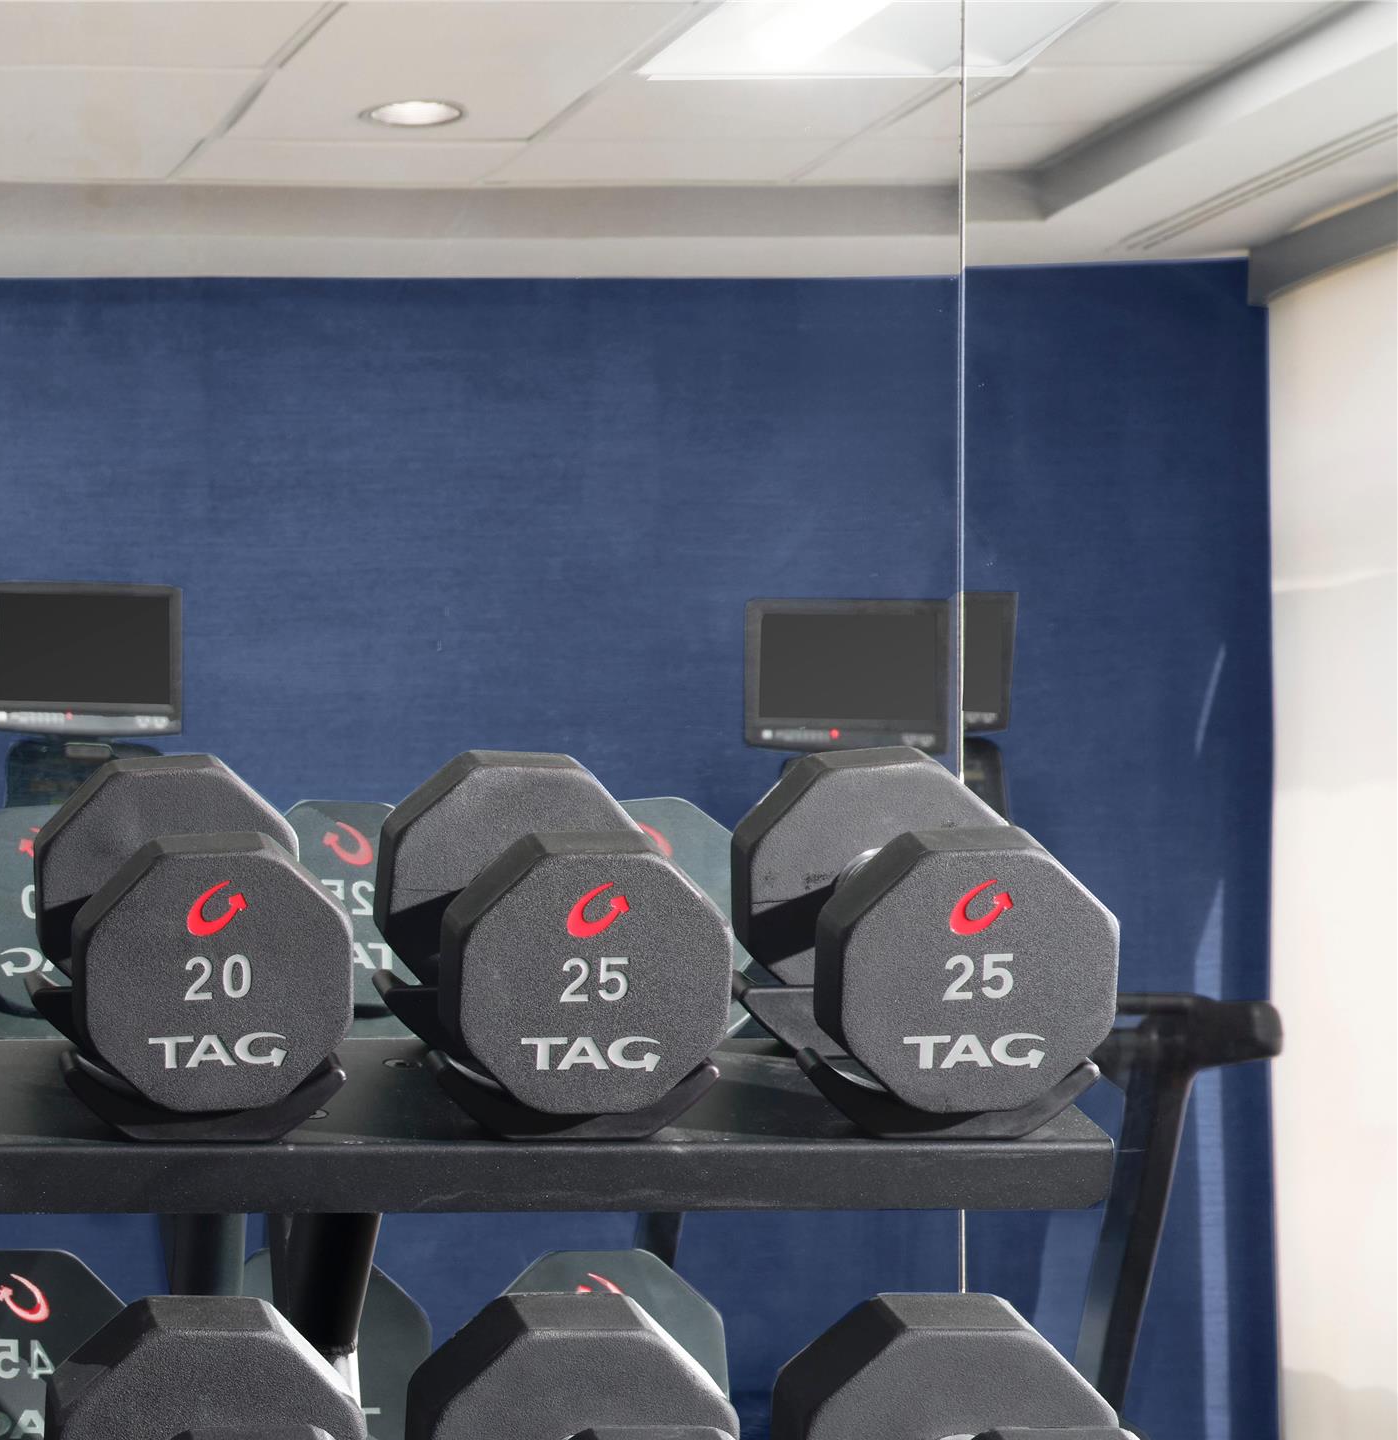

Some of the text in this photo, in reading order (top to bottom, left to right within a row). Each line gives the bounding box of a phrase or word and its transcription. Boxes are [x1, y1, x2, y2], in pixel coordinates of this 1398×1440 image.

[182, 952, 252, 1003] 20
[558, 955, 629, 1004] 25
[941, 951, 1015, 1002] 25
[147, 1030, 287, 1070] TAG
[519, 1034, 661, 1073] TAG
[901, 1031, 1046, 1071] TAG
